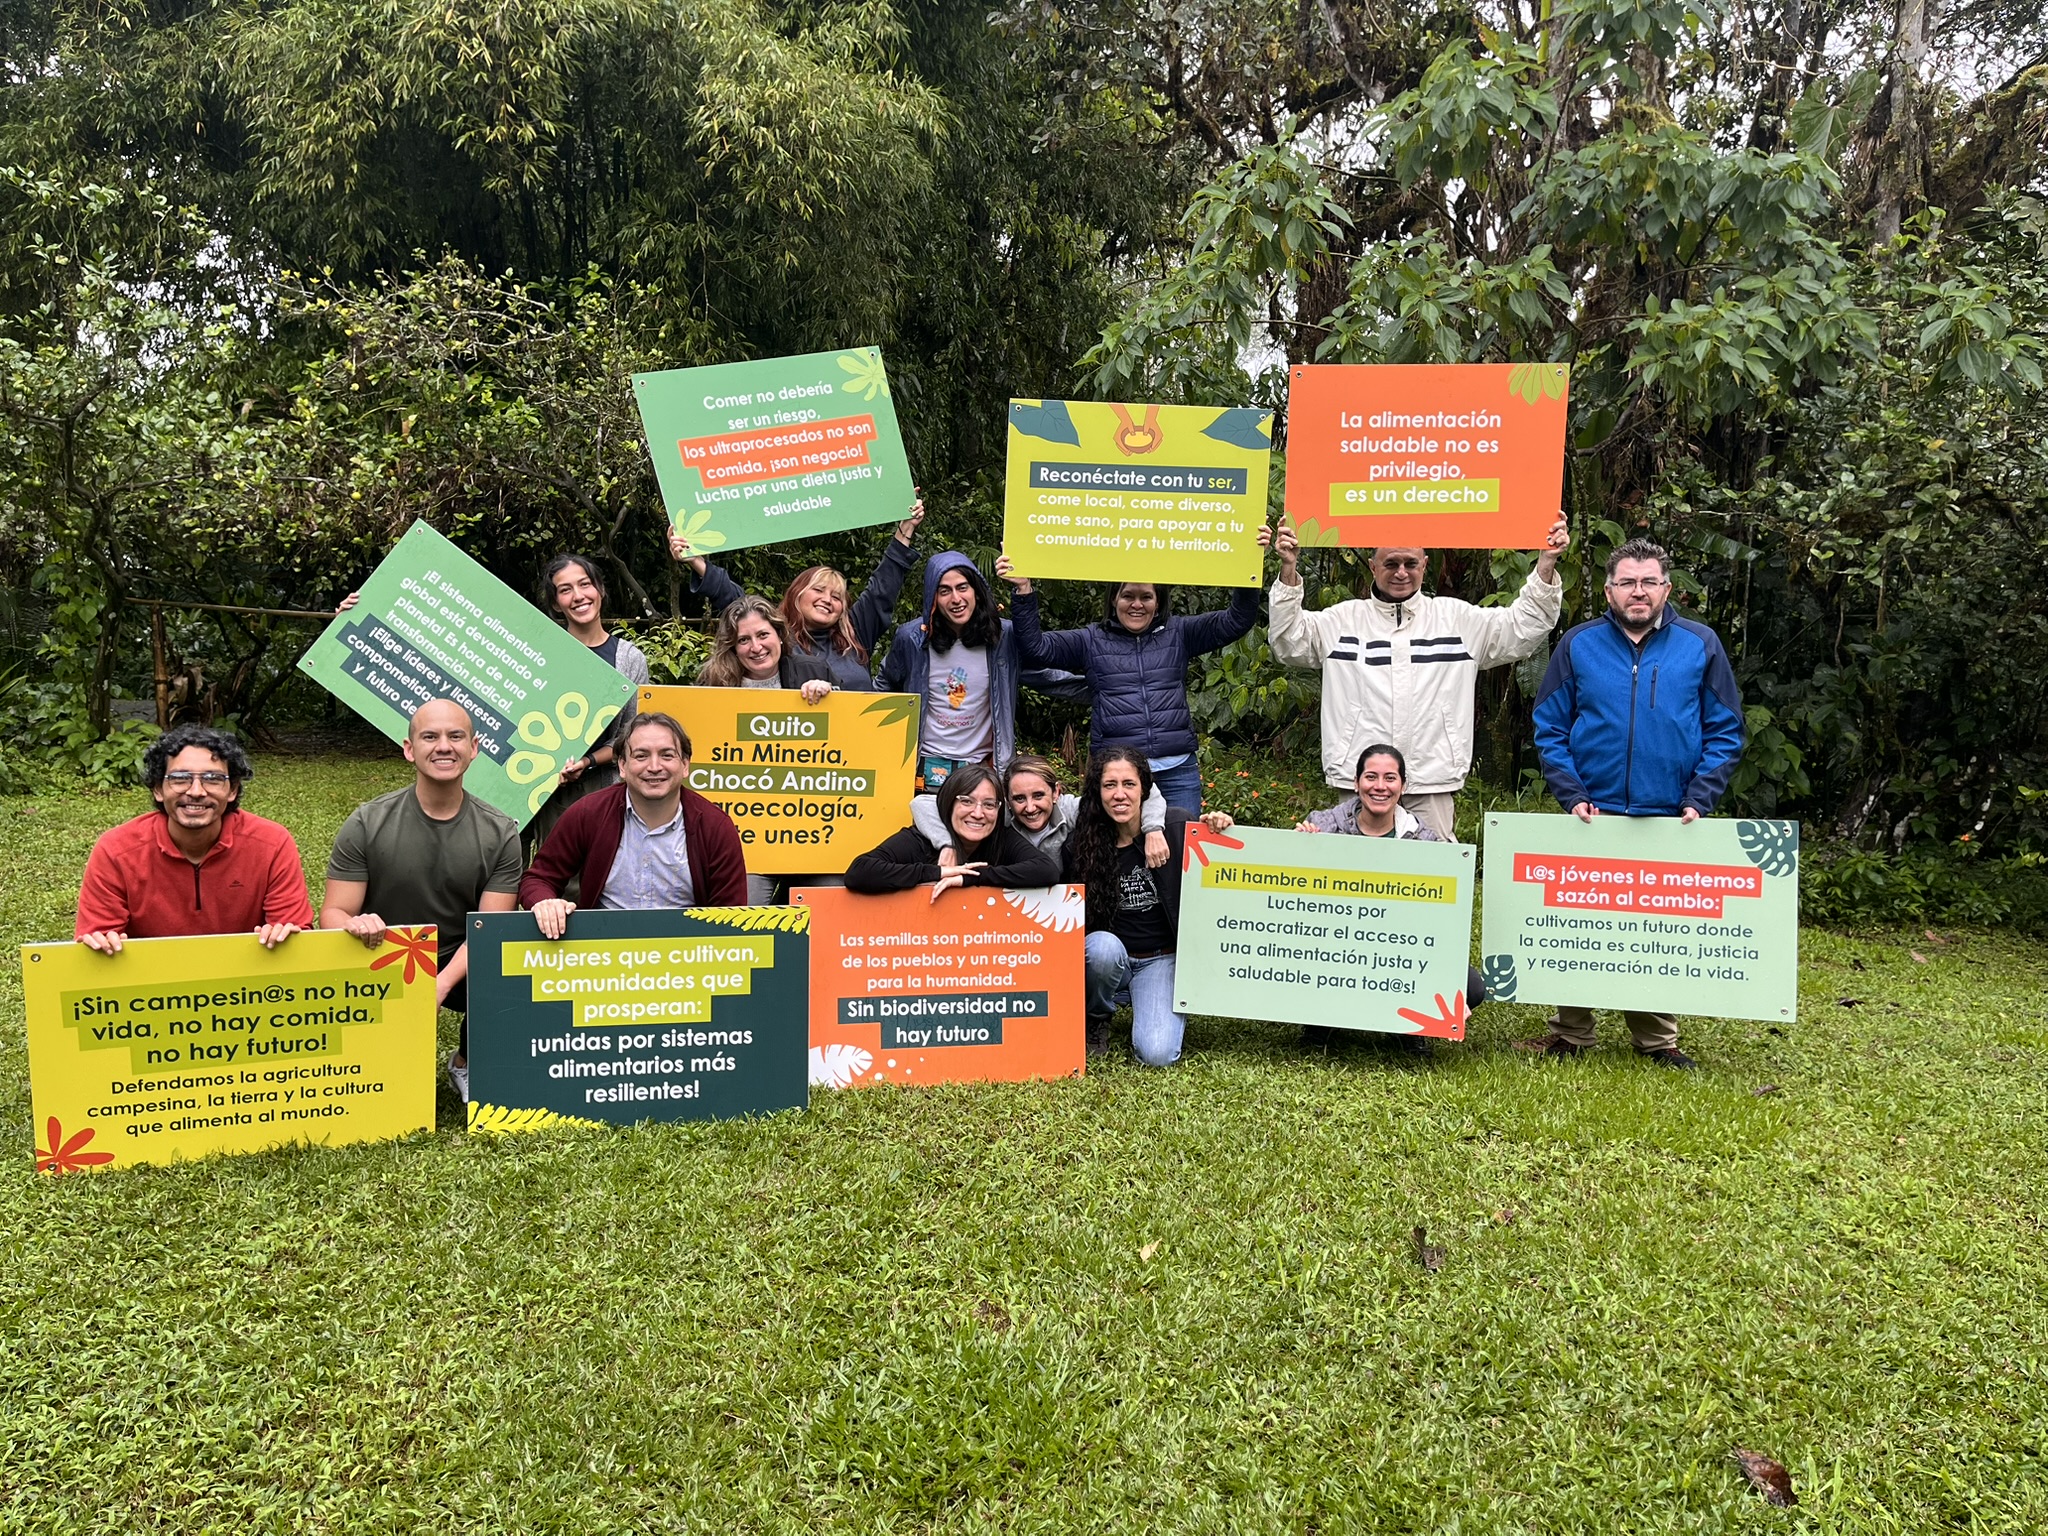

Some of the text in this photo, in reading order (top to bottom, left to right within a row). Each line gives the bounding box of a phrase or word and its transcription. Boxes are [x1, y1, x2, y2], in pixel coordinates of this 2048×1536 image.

[703, 380, 833, 410] Comer no debería
[728, 409, 821, 430] ser un riesgo,
[1341, 409, 1501, 428] La alimentación
[684, 423, 871, 459] los ultraprocesados no son
[1340, 436, 1499, 453] saludable no es
[706, 444, 863, 479] comida, ¡son negocio!
[1369, 461, 1466, 482] privilegio,
[1040, 467, 1236, 491] Reconéctate con tu ser,
[763, 495, 831, 517] saludable
[1038, 494, 1235, 513] come local, come diverso,
[1346, 486, 1489, 503] es un derecho
[1028, 514, 1244, 534] come sano, para apoyar a tu
[1035, 533, 1234, 552] comunidad y a tu territorio.
[422, 570, 546, 667] ¡El sistema alimentario
[400, 578, 548, 691] global está devastando el
[394, 596, 527, 700] planeta! Es hora de una
[385, 609, 513, 713] transformación radical.
[368, 627, 501, 731] ¡Elige líderes y lideresas
[750, 715, 815, 737] Quito
[711, 742, 847, 766] sin Minería,
[689, 768, 867, 792] Chocó Andino
[1215, 868, 1443, 899] ¡Ni hambre ni malnutrición!
[1526, 865, 1755, 889] L@s jóvenes le metemos
[1268, 895, 1387, 920] Luchemos por
[1556, 887, 1720, 910] sazón al cambio:
[840, 930, 1043, 947] Las semillas son patrimonio
[1217, 915, 1434, 947] democratizar el acceso a
[1525, 915, 1753, 938] cultivamos un futuro donde
[523, 944, 759, 971] Mujeres que cultivan,
[1220, 942, 1428, 974] una alimentación justa y
[1520, 934, 1758, 960] la comida es cultura, justicia
[1229, 965, 1415, 994] saludable para tod@s!
[1527, 958, 1749, 981] y regeneración de la vida.
[541, 972, 743, 994] comunidades que
[867, 972, 1016, 992] para la humanidad.
[74, 981, 390, 1020] ¡Sin campesin@s no hay
[584, 1001, 702, 1023] prosperan:
[848, 997, 1036, 1017] Sin biodiversidad no
[92, 1006, 374, 1040] vida, no hay comida,
[531, 1028, 753, 1057] ¡unidas por sistemas
[896, 1025, 989, 1046] hay futuro
[147, 1033, 327, 1064] no hay futuro!
[549, 1051, 736, 1078] alimentarios más
[112, 1064, 361, 1094] Defendamos la agricultura
[586, 1080, 699, 1103] resilientes!
[126, 1104, 349, 1137] que alimenta al mundo.
